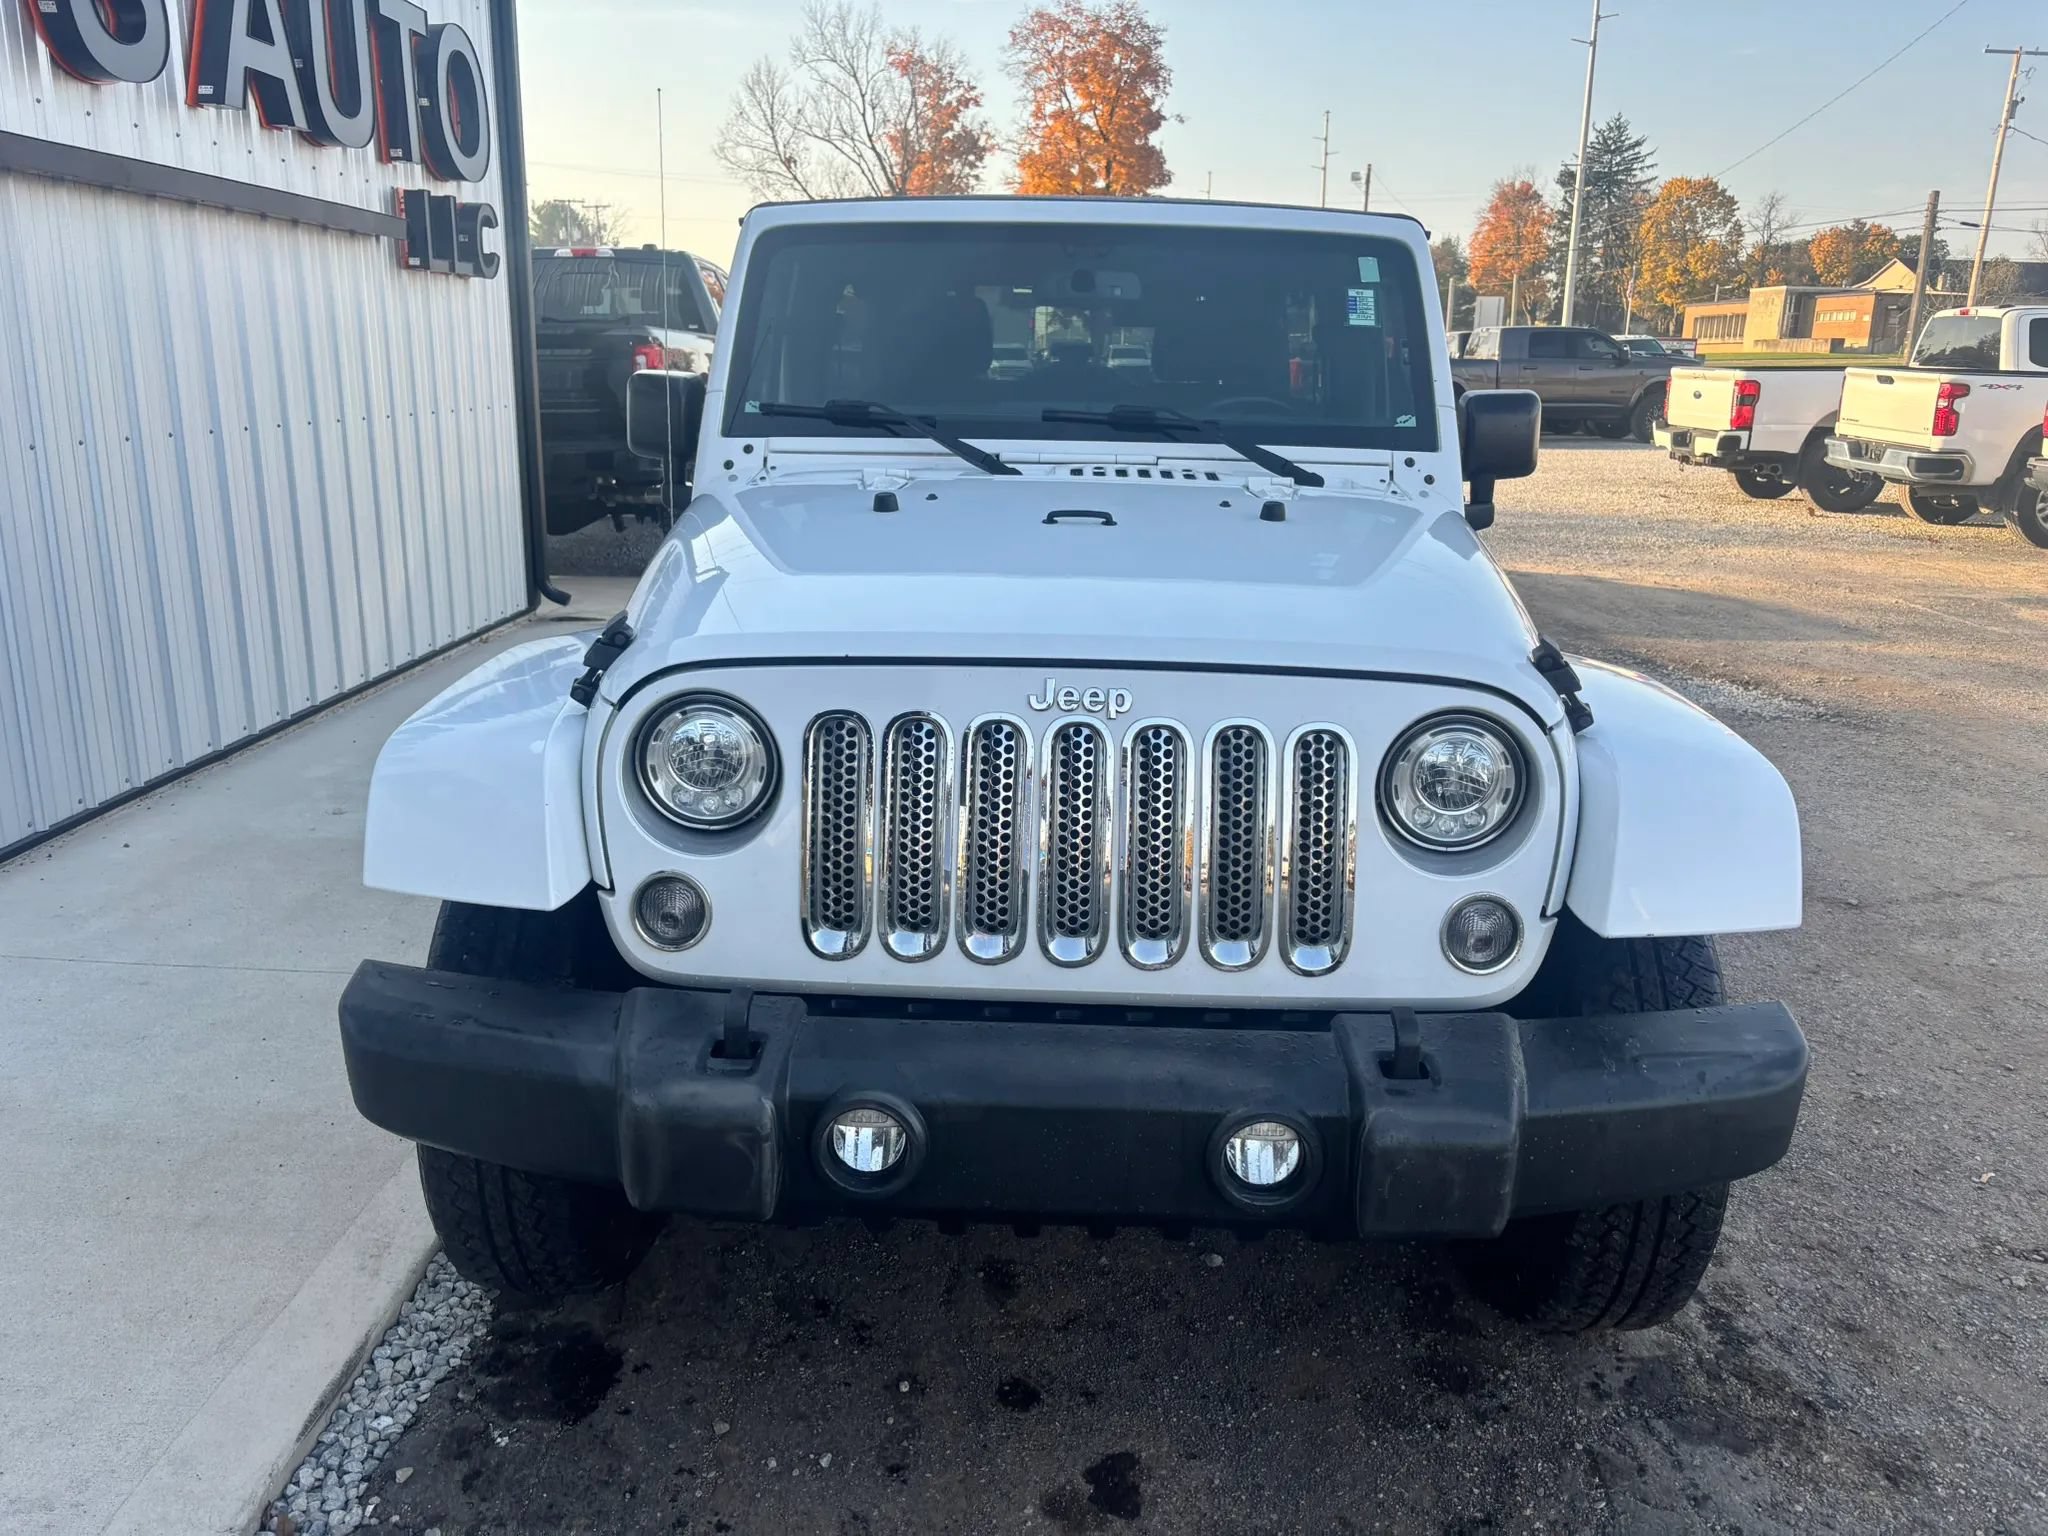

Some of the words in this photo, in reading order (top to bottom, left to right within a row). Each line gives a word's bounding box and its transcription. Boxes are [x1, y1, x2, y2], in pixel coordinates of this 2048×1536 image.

[192, 0, 491, 183] AUTO
[403, 188, 500, 279] LLC
[1027, 677, 1133, 720] Jeep
